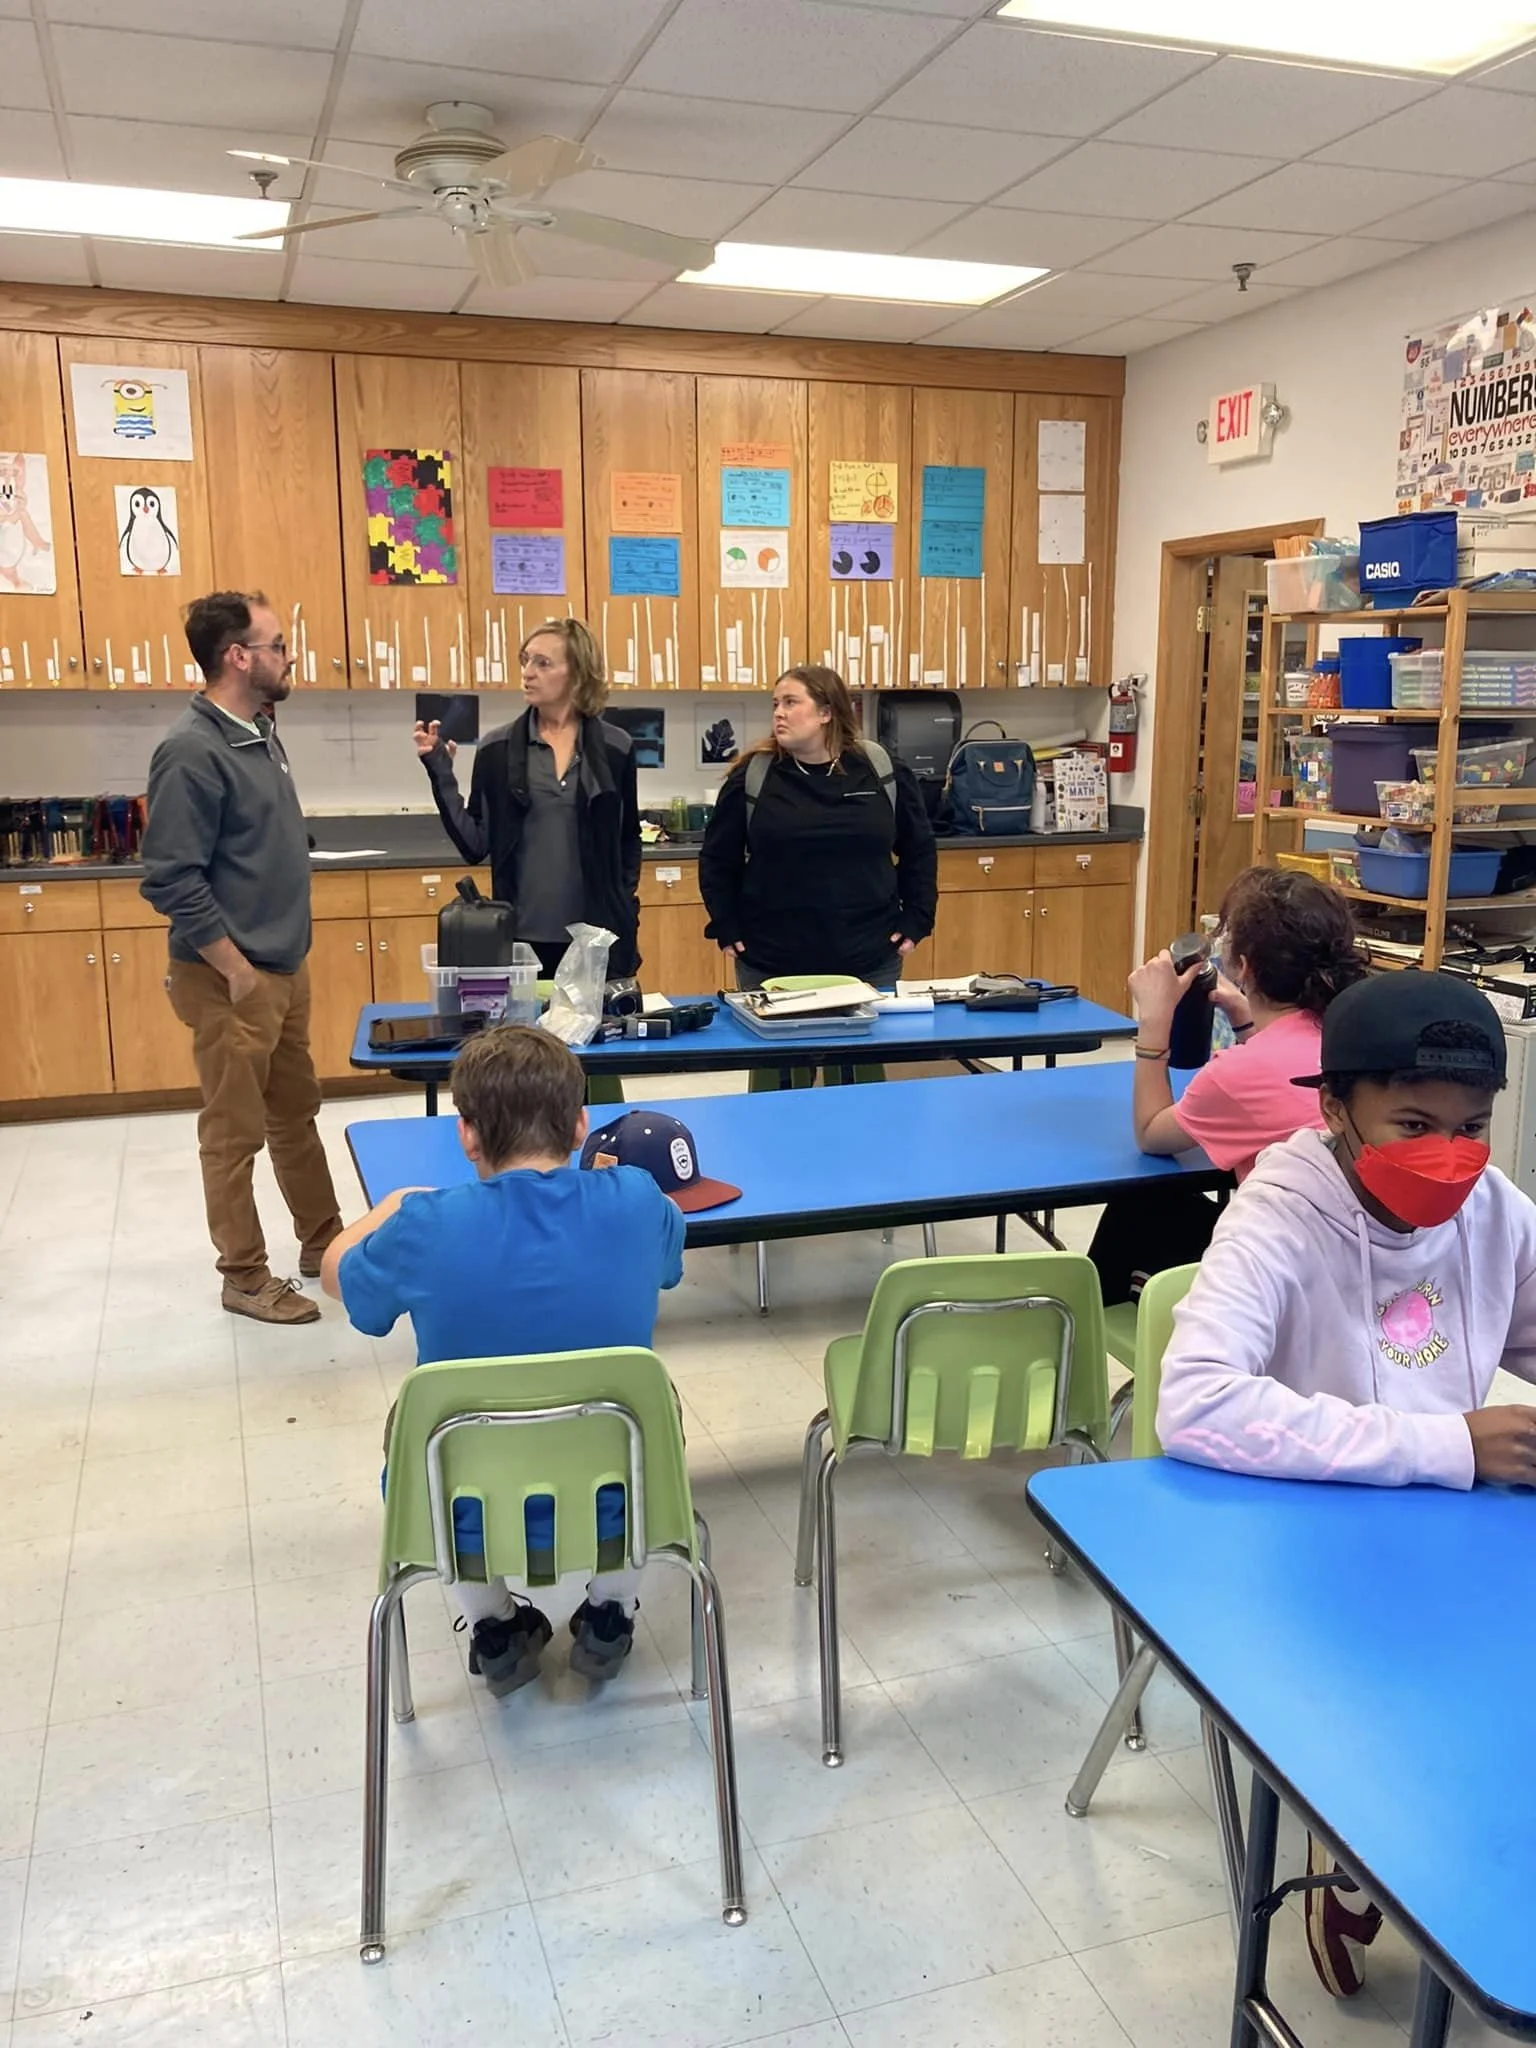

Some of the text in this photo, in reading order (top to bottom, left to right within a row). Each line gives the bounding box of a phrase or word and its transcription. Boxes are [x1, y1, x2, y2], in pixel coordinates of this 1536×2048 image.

[1454, 379, 1457, 389] 1
[1460, 377, 1466, 387] 2
[1470, 375, 1476, 385] 3
[1480, 373, 1486, 381] 4
[1489, 371, 1495, 380] 5
[1498, 368, 1504, 378] 6
[1506, 366, 1512, 376] 7
[1515, 363, 1521, 373] 8
[1524, 361, 1530, 371] 9
[1450, 372, 1536, 429] NUMBER
[1216, 391, 1253, 442] EXIT
[1449, 448, 1458, 459] 10
[1461, 447, 1467, 457] 9
[1471, 445, 1477, 455] 8
[1480, 443, 1486, 454] 7
[1489, 441, 1495, 451] 6
[1498, 439, 1504, 449] 5
[1507, 438, 1513, 447] 4
[1516, 435, 1522, 446] 3
[1525, 433, 1531, 444] 2
[1365, 561, 1400, 580] CASIO
[1069, 787, 1095, 796] MATH
[1378, 1331, 1449, 1369] YOUR HOME
